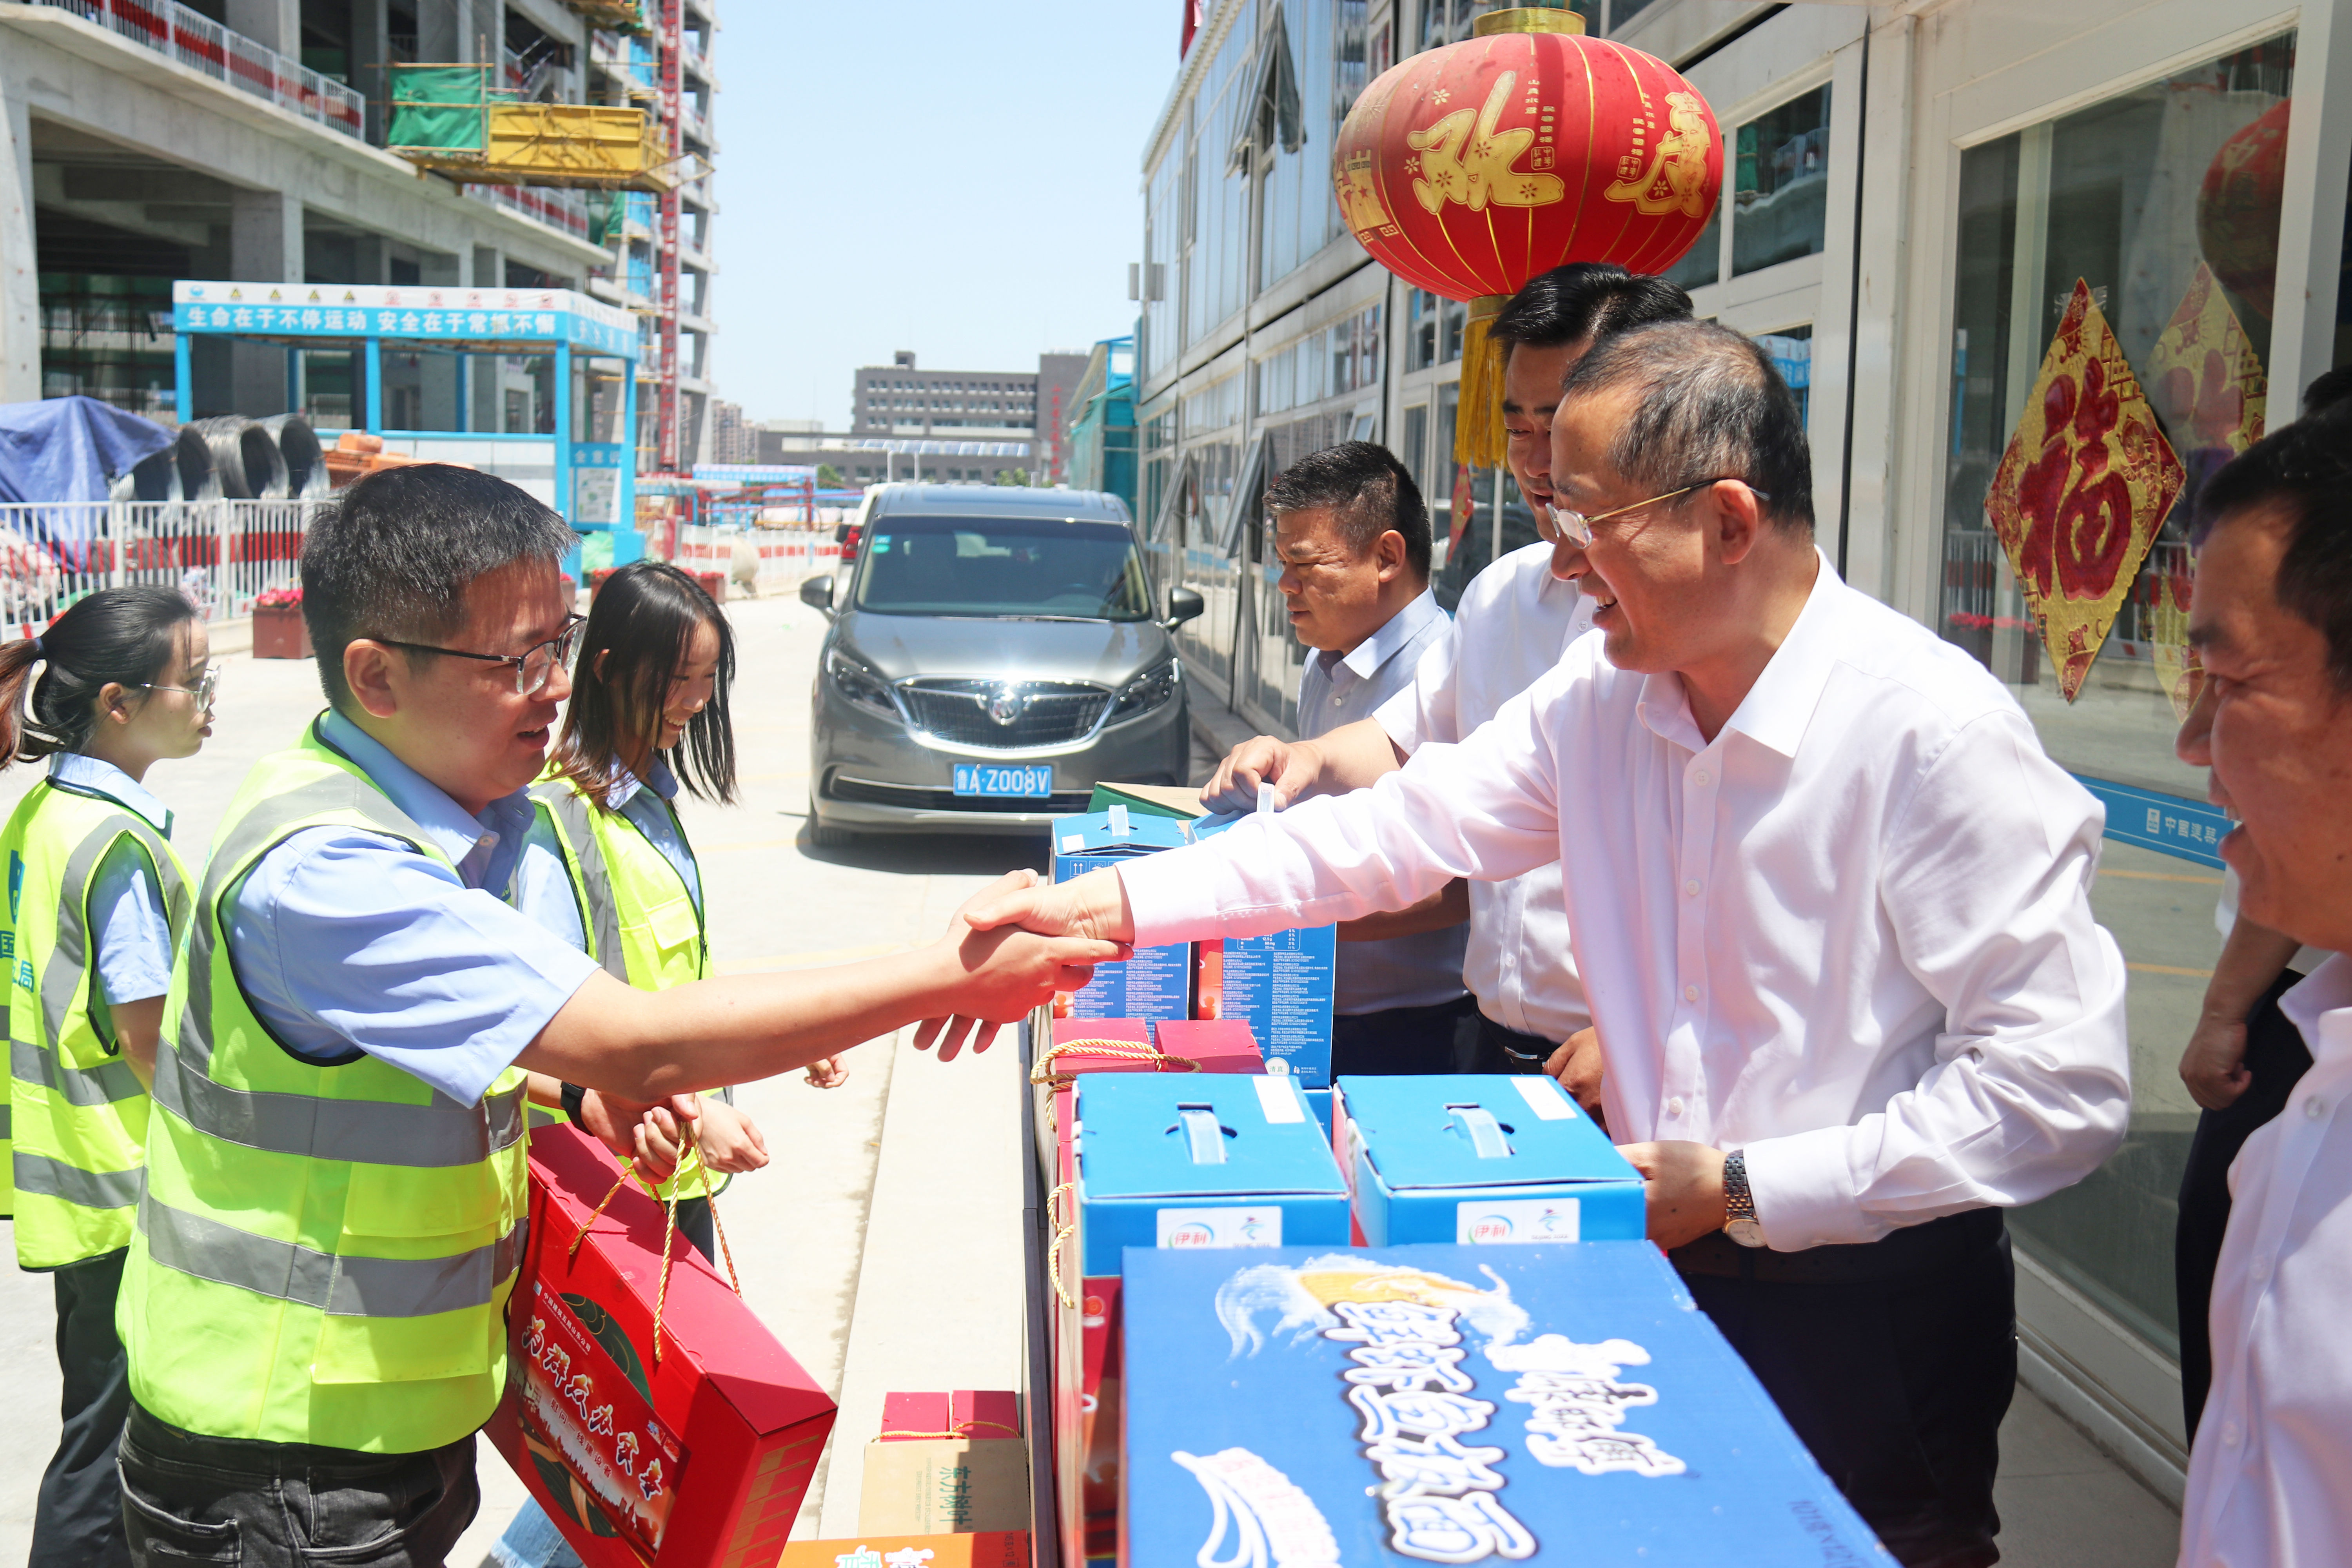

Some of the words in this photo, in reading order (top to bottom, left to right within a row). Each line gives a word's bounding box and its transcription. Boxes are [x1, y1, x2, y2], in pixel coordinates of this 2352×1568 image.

[188, 307, 367, 330] 生命在于不停运动
[377, 310, 555, 334] 安全在于常抓不懈
[2018, 357, 2132, 601] 福
[1174, 1232, 1207, 1245] 伊利
[1474, 1225, 1506, 1238] 伊利
[543, 1292, 591, 1352] 中国建筑五局山东公司
[521, 1315, 663, 1501] 为群众办实事
[550, 1397, 612, 1479] 慰问一线建设者
[1323, 1301, 1536, 1563] 鲜虾鱼板面
[939, 1466, 973, 1525] 东方树叶
